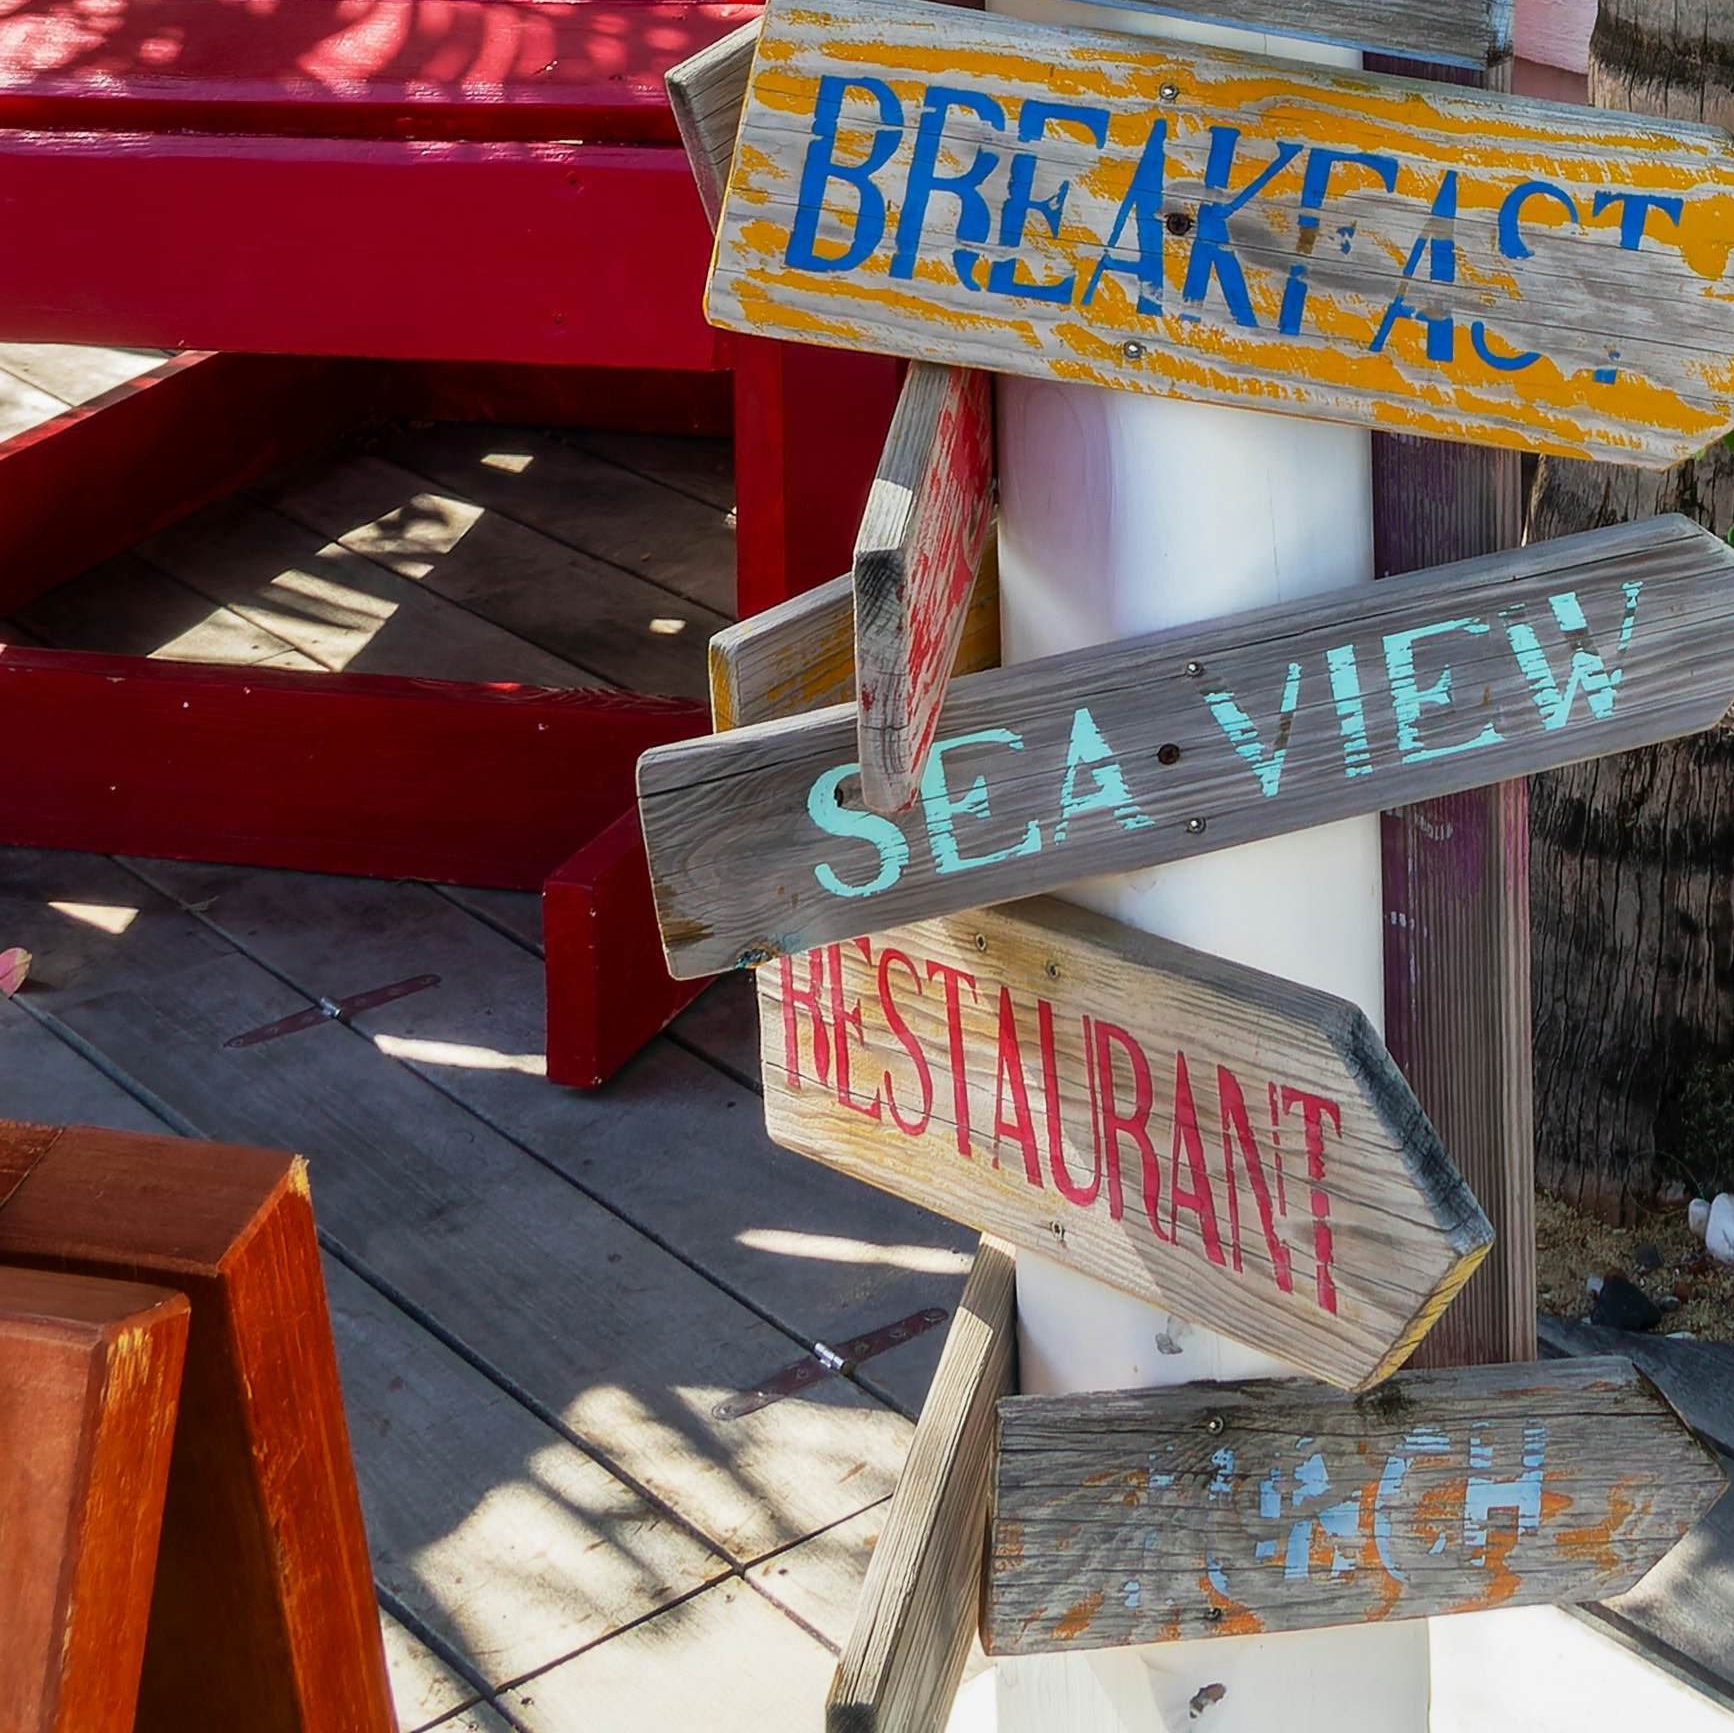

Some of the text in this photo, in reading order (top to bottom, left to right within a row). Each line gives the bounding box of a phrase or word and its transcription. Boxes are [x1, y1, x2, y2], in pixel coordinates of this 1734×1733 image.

[806, 580, 1644, 899] SEA VIEW
[779, 935, 1343, 1317] RESTAURANT
